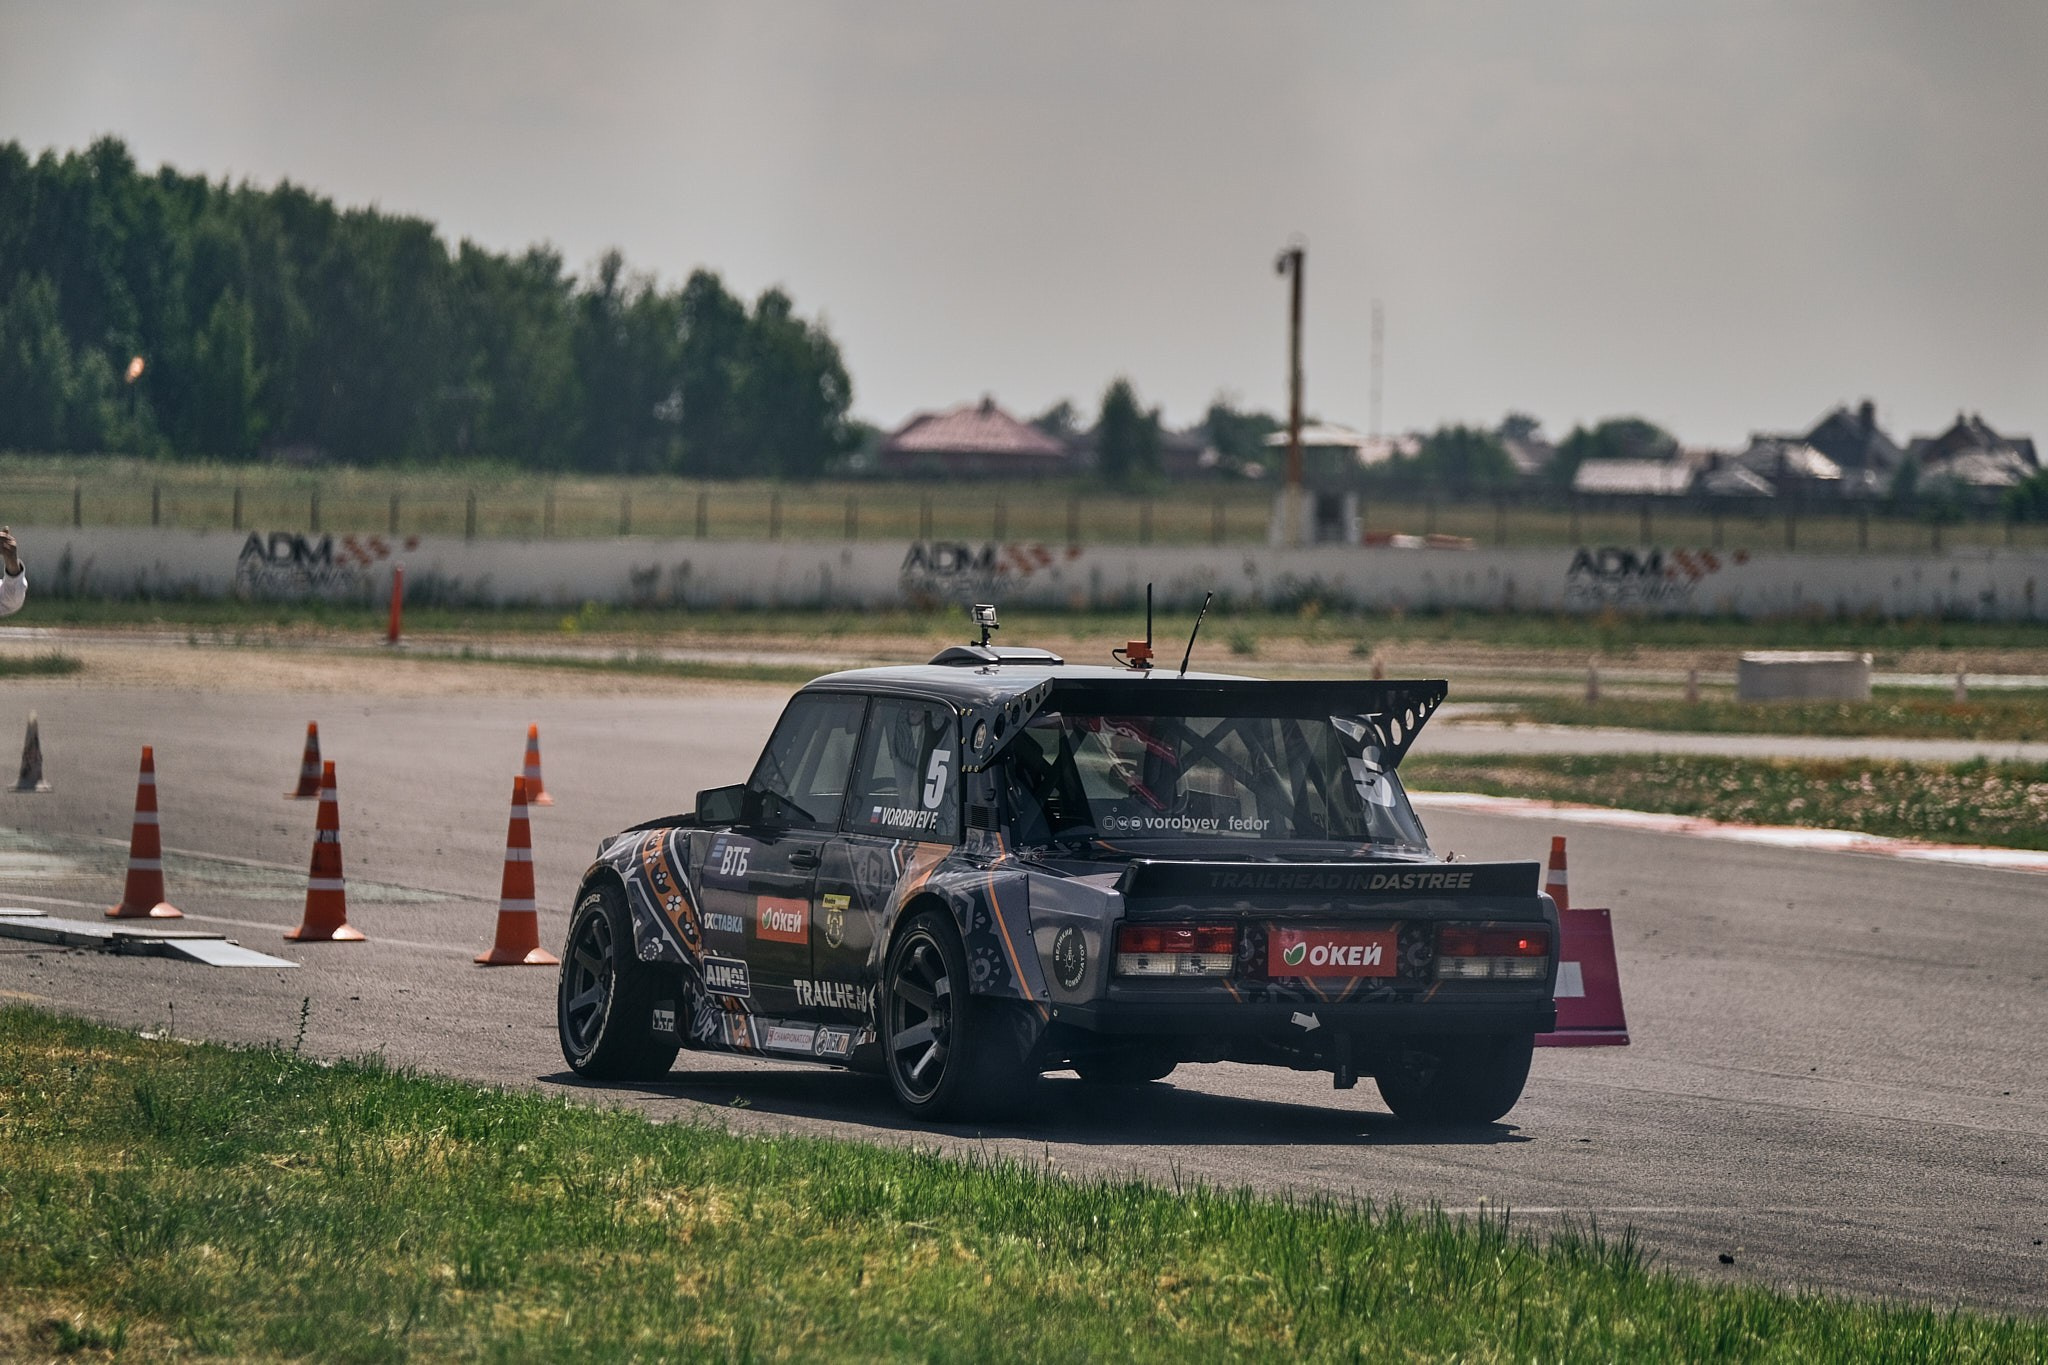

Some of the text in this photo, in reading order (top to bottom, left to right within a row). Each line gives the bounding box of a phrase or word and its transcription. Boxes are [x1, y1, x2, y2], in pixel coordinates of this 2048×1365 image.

[238, 531, 333, 567] ADM
[901, 541, 997, 576] ADM
[1568, 546, 1664, 581] ADM
[924, 748, 951, 809] 5
[881, 807, 931, 829] VOROBYEV
[720, 845, 750, 876] ВТБ
[1209, 872, 1473, 890] TRAILHEAD INDASTREE
[1055, 927, 1073, 961] ВЕЛИКИЙ
